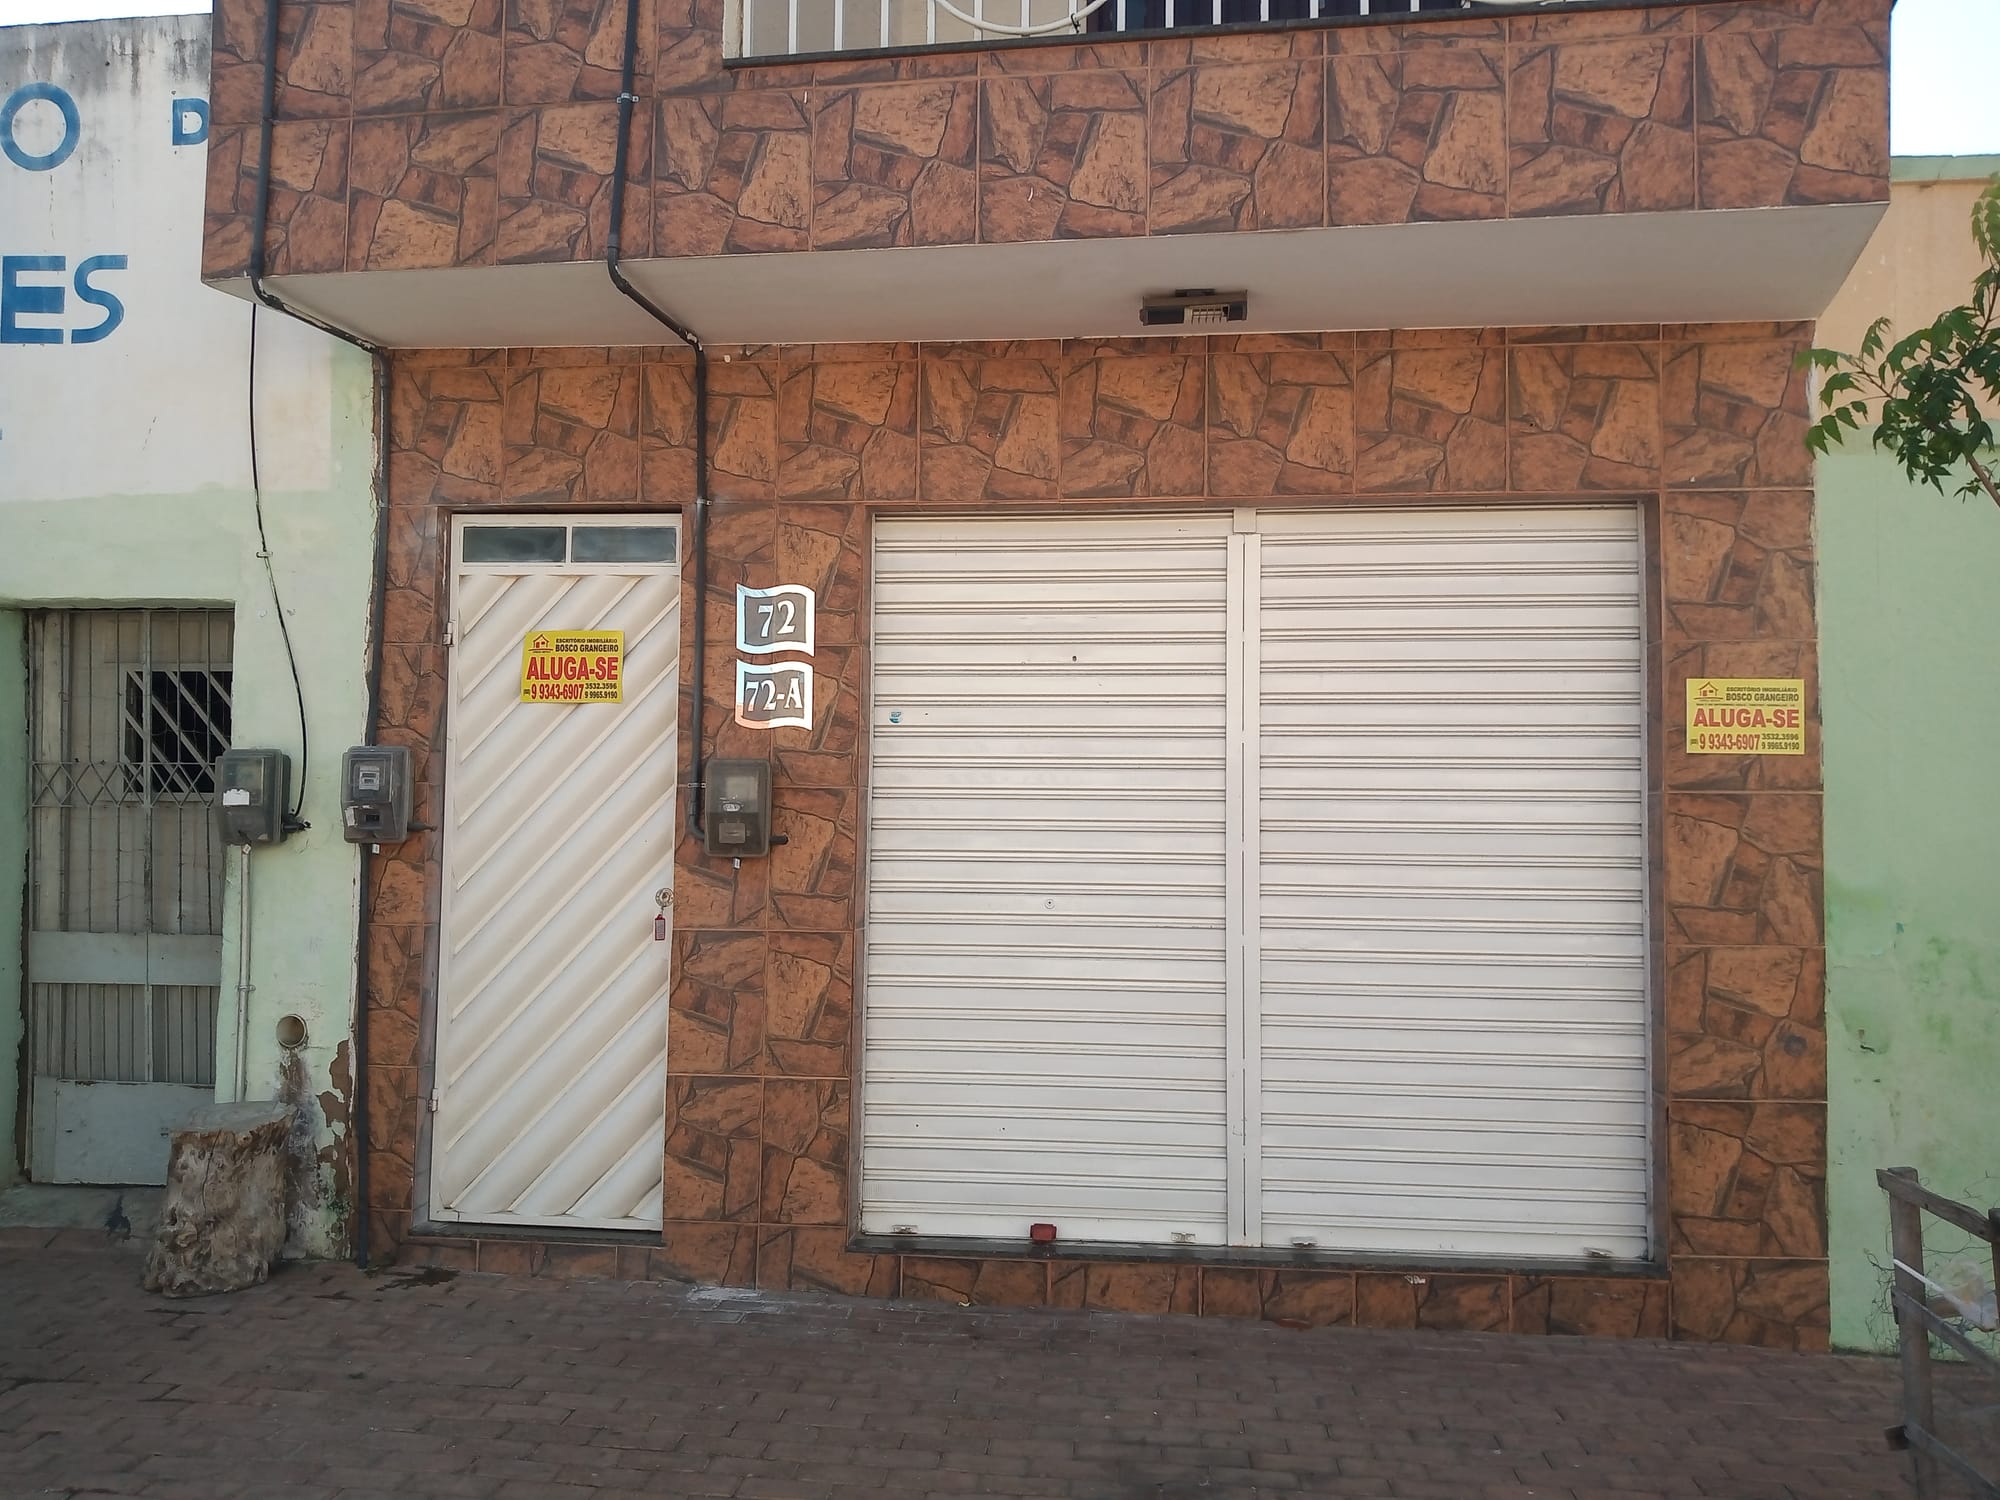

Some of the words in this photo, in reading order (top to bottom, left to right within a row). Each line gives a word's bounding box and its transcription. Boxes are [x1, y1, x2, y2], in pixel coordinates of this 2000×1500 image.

[0, 255, 128, 344] ES
[758, 600, 796, 637] 72
[555, 644, 578, 652] BOSCO
[580, 644, 619, 652] GRANGEIRO
[526, 656, 619, 680] ALUGA-SE
[531, 683, 537, 699] 9
[539, 683, 585, 699] 9343-6907
[745, 677, 803, 712] 72-A
[1726, 693, 1752, 701] BOSCO
[1754, 693, 1799, 701] GRANGEIRO
[1693, 708, 1800, 728] ALUGA-SE
[1700, 733, 1706, 749] 9
[1708, 733, 1760, 750] 9343-6907
